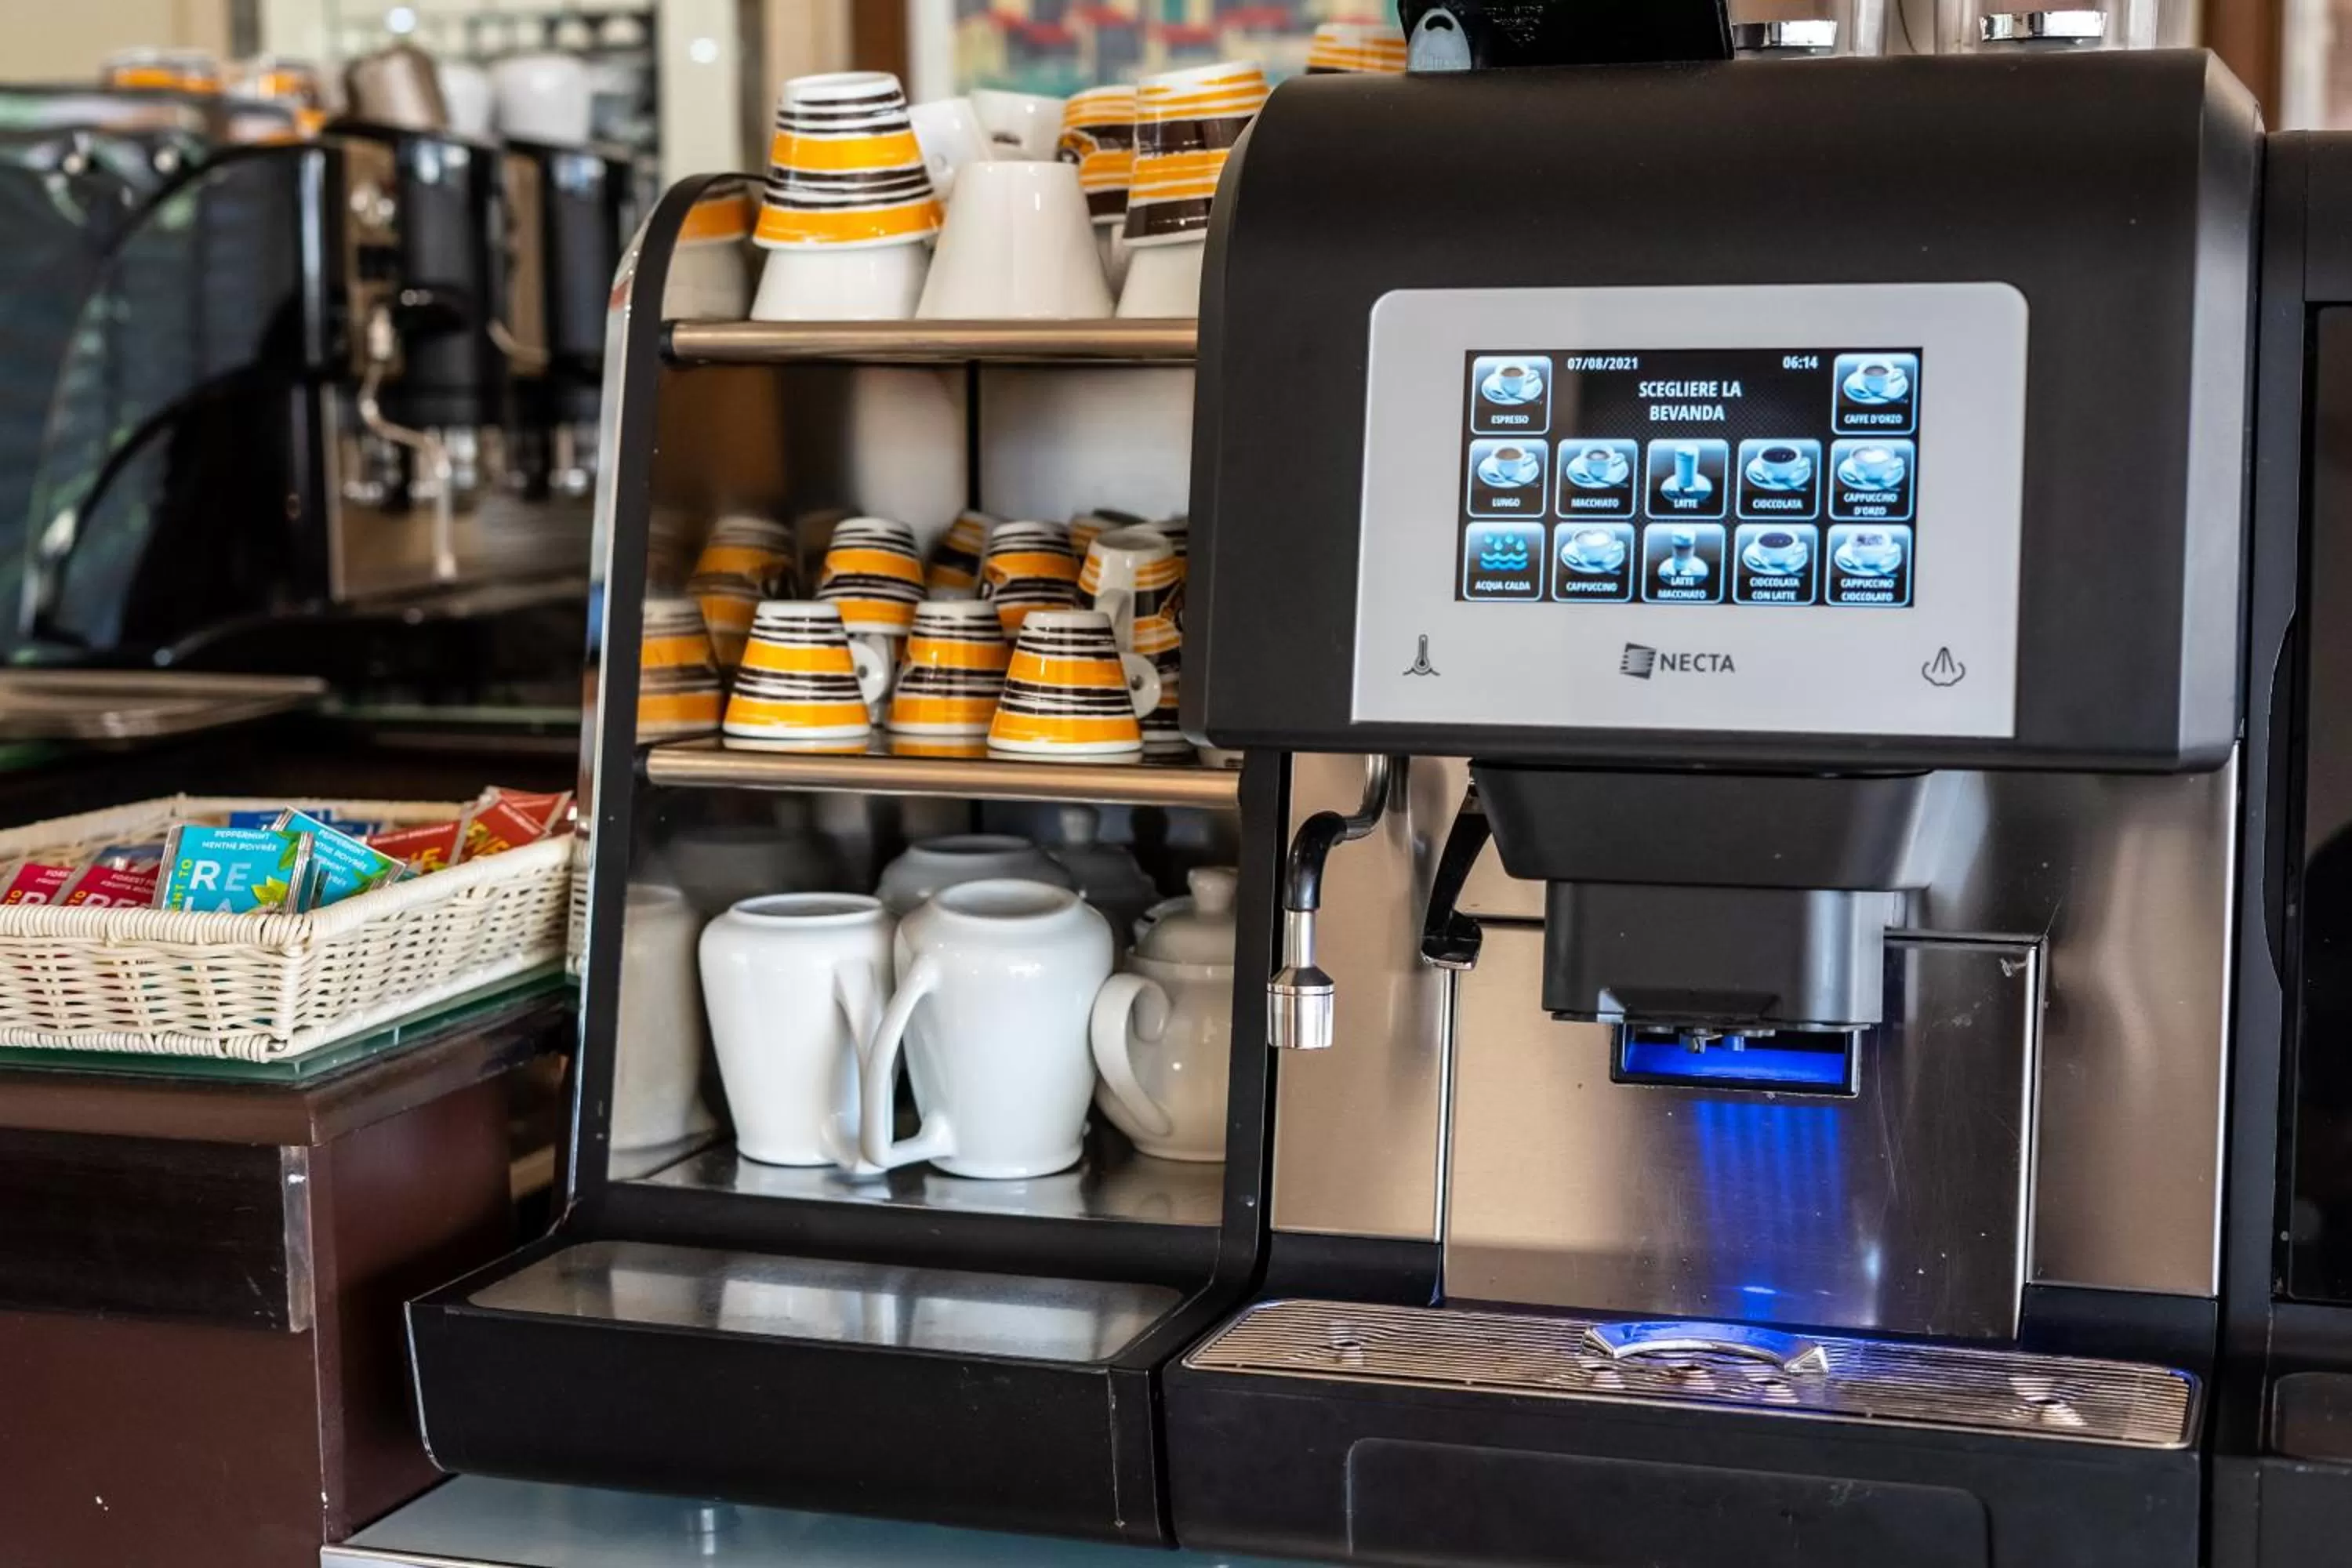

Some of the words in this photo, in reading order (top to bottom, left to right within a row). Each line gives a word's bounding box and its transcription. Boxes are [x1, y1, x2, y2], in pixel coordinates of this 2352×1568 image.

[1567, 357, 1638, 371] 07/08/2021
[1782, 355, 1819, 369] 06:14
[1639, 380, 1719, 397] SCEGLIERE
[1722, 380, 1742, 397] LA
[1649, 405, 1725, 421] BEVANDA
[1491, 414, 1529, 424] ESPRESSO
[1492, 497, 1520, 508] LUNGO
[1570, 498, 1620, 508] MACCHIATO
[1843, 493, 1898, 503] CAPPUCCINO
[1673, 499, 1698, 509] LATTE
[1752, 499, 1803, 509] CIOCCOLATA
[1475, 580, 1503, 592] ACQUA
[1504, 581, 1530, 590] CALDA
[1670, 576, 1695, 586] LATTE
[1749, 577, 1800, 587] CIOCCOLATA
[1840, 578, 1894, 588] CAPPUCCINO
[1566, 582, 1617, 592] CAPPUCCINO
[1751, 590, 1771, 601] CON
[1772, 590, 1796, 601] LATTE
[1659, 652, 1736, 673] NECTA
[214, 830, 270, 840] PEPPERMINT
[201, 840, 237, 850] MENTHE
[189, 859, 252, 891] RE
